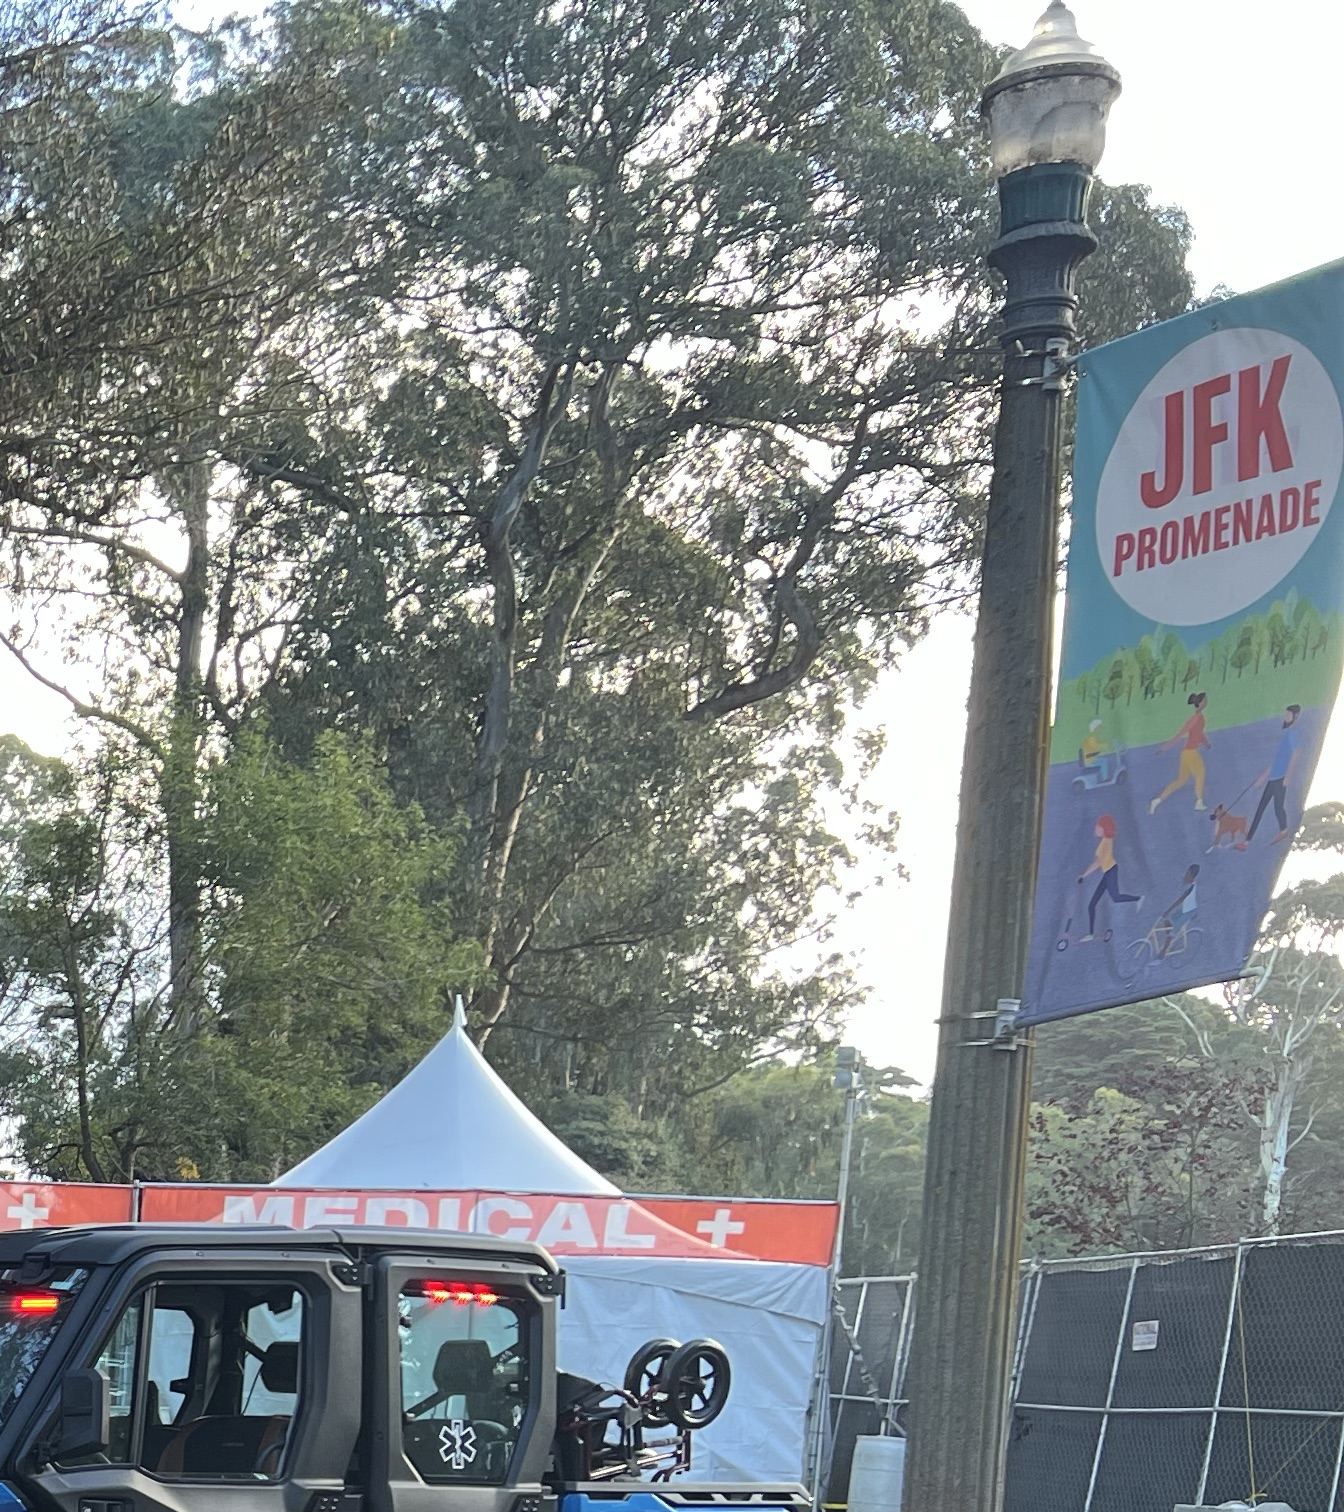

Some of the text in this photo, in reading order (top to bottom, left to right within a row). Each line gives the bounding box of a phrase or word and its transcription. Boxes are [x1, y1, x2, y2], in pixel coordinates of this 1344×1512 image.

[1140, 353, 1294, 509] JFK
[1113, 479, 1322, 577] PROMENADE
[223, 1195, 656, 1249] MEDICAL
